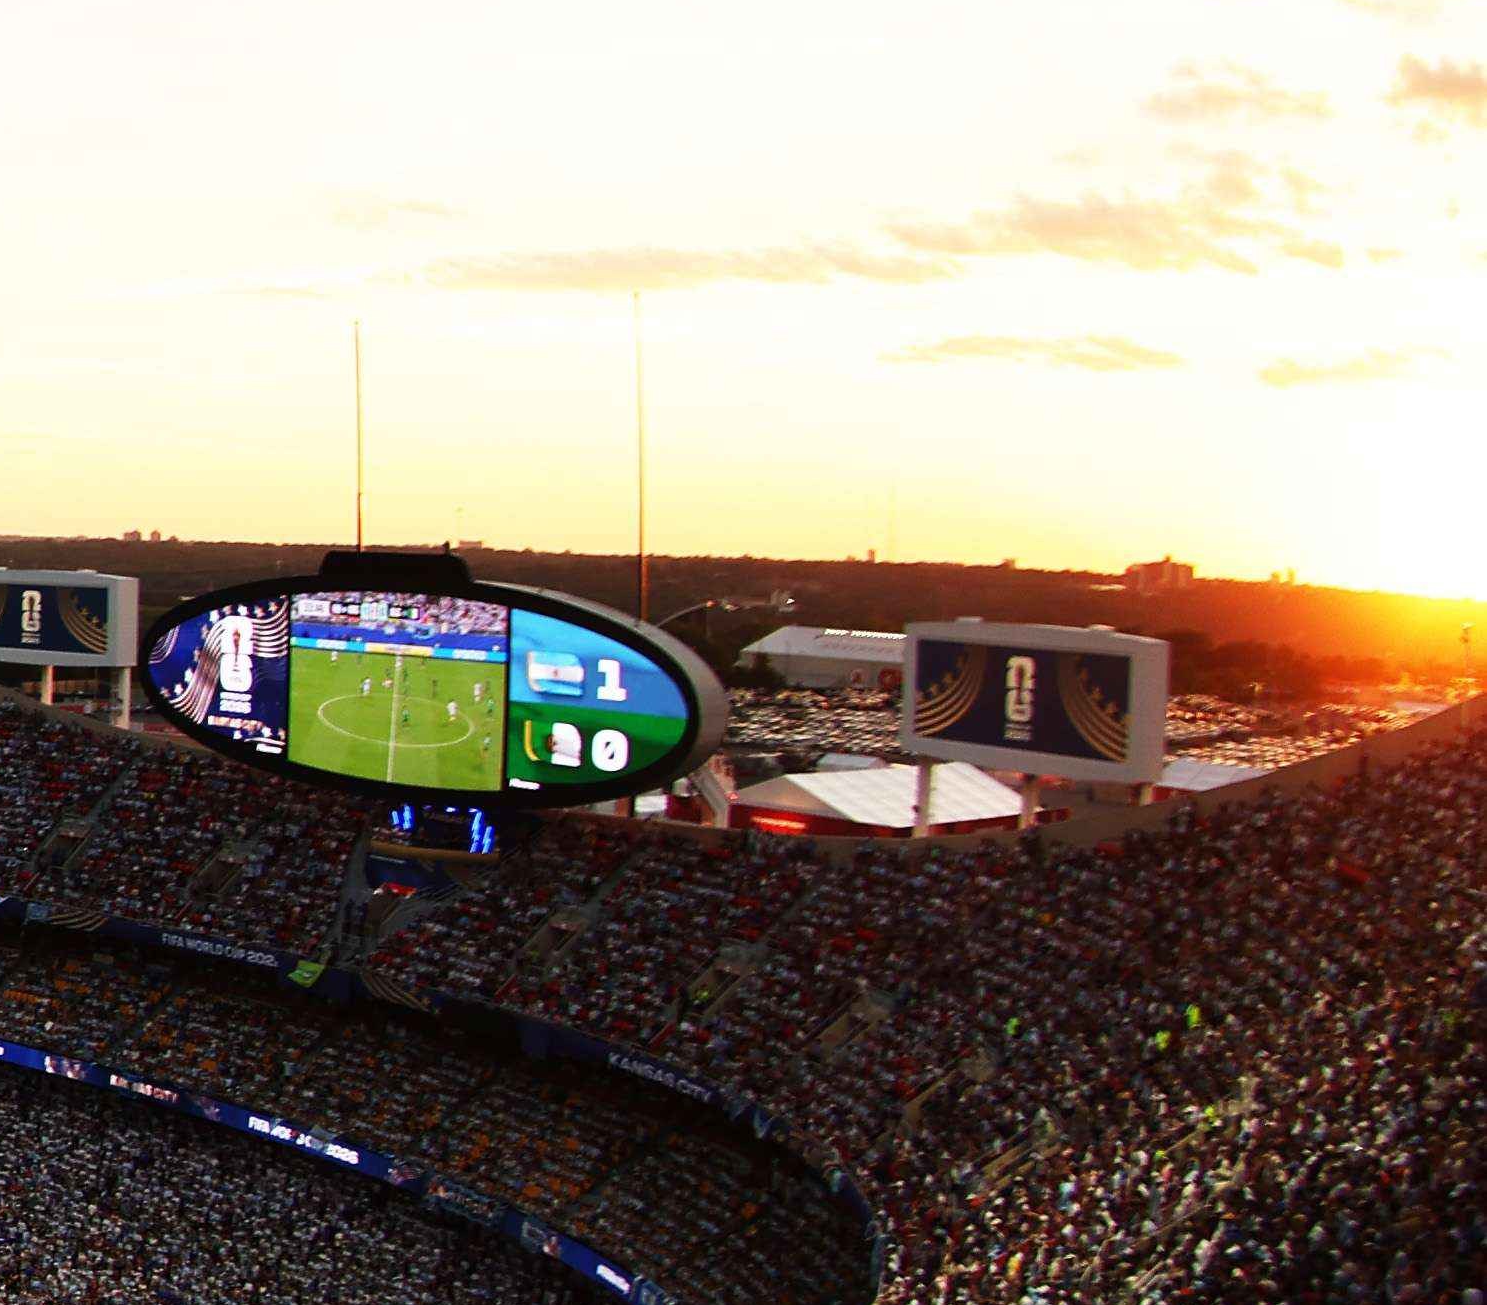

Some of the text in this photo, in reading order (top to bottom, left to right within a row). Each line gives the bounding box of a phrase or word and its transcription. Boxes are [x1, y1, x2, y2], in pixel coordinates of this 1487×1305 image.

[596, 659, 628, 702] 1
[591, 729, 629, 772] 0
[246, 950, 278, 968] 202
